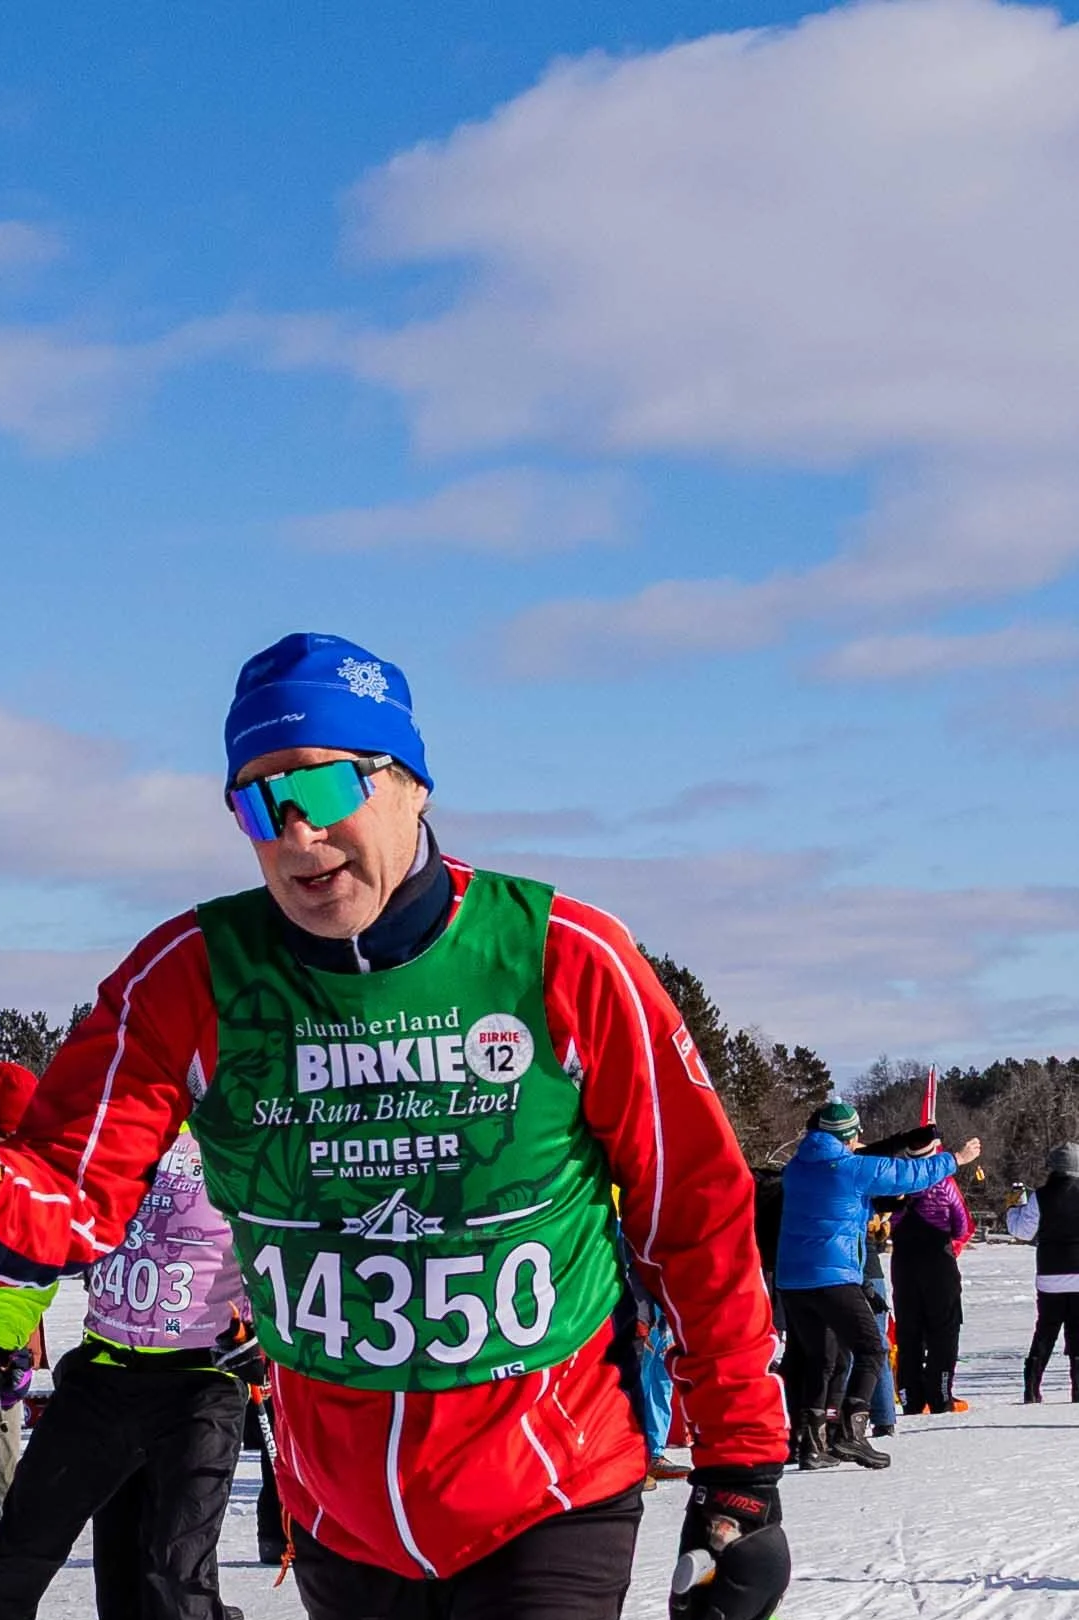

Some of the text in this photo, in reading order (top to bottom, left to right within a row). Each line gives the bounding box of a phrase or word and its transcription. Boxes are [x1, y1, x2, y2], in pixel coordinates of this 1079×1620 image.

[295, 1007, 460, 1038] slumberland
[479, 1031, 521, 1044] BIRKIE
[295, 1034, 467, 1094] BIRKIE
[484, 1044, 515, 1072] 12
[253, 1082, 520, 1125] Ski. Run. Bike. Live!
[309, 1134, 459, 1164] PIONEER
[339, 1162, 431, 1179] MIDWEST
[91, 1253, 195, 1313] 8403
[253, 1240, 557, 1368] 14350
[493, 1363, 524, 1380] US
